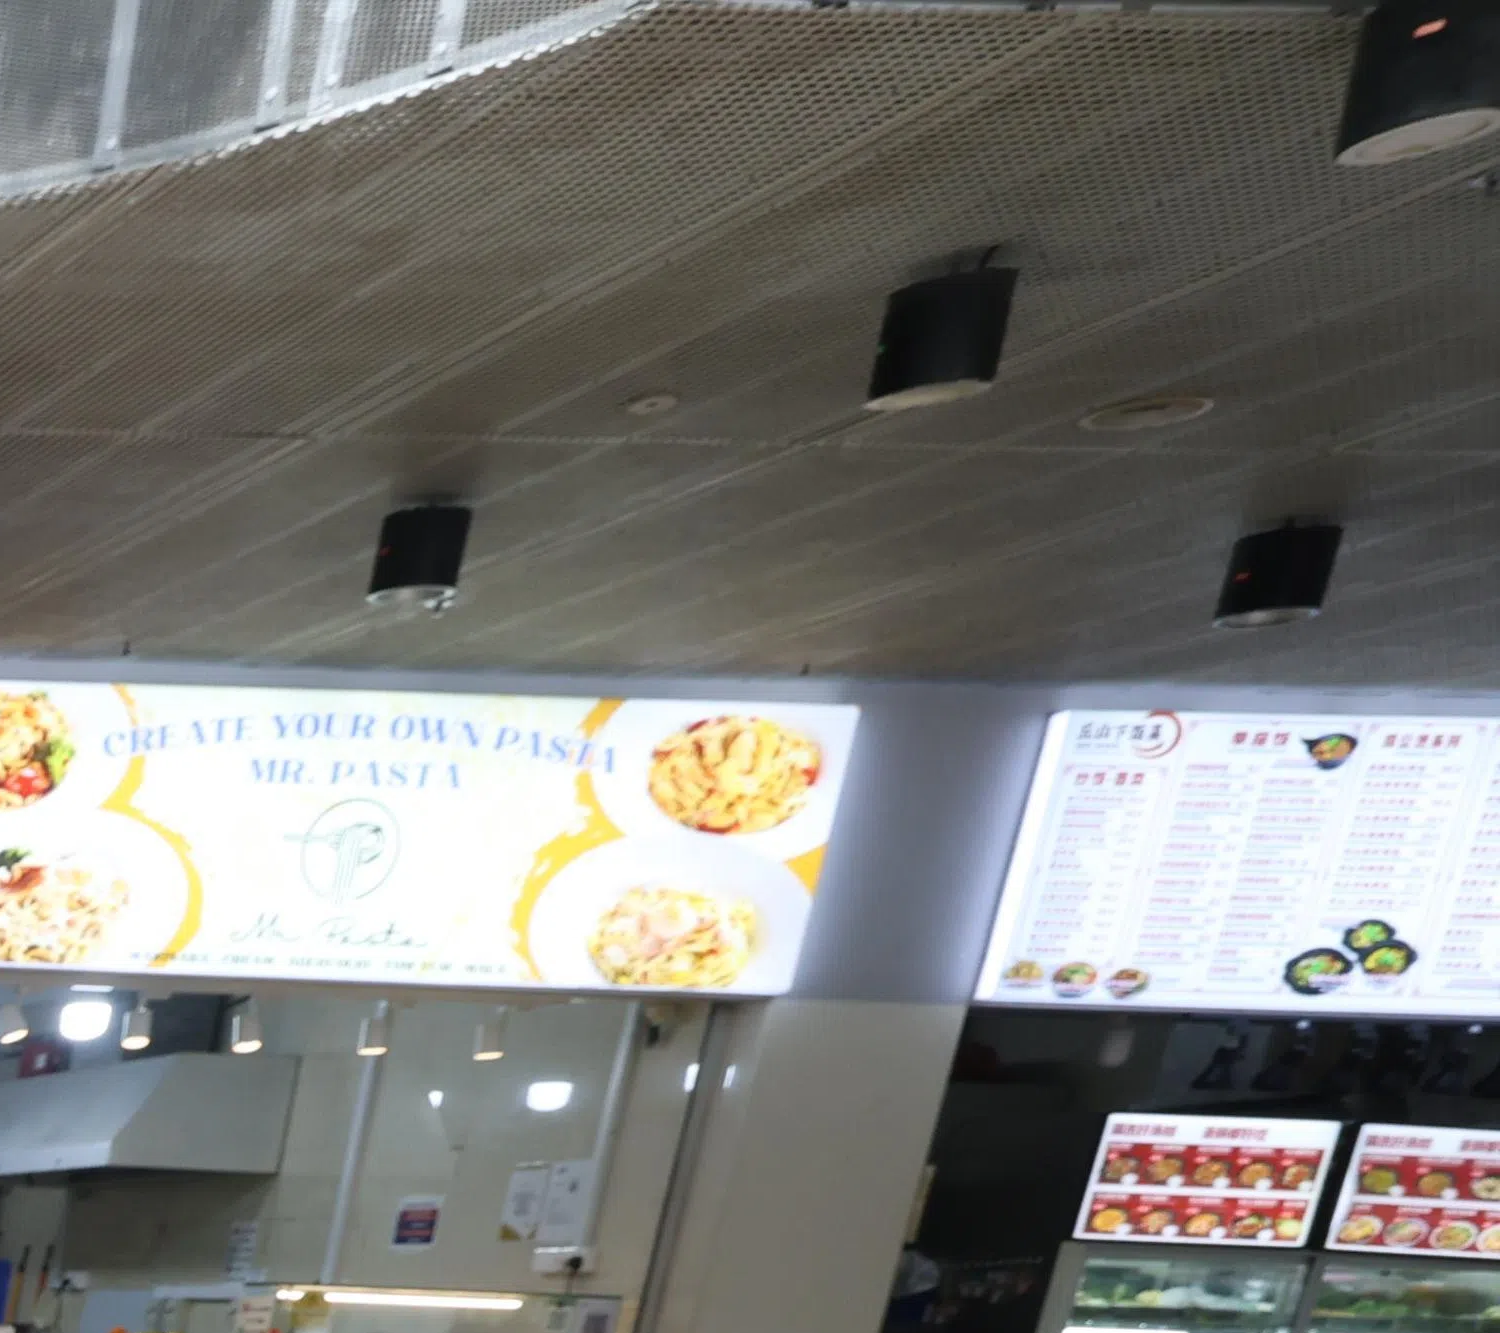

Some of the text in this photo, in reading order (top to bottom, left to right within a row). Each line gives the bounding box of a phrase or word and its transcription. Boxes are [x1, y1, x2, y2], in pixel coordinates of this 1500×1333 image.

[103, 712, 618, 776] CREATE YOUR OWN PASTA
[250, 758, 462, 789] MR. PASTA
